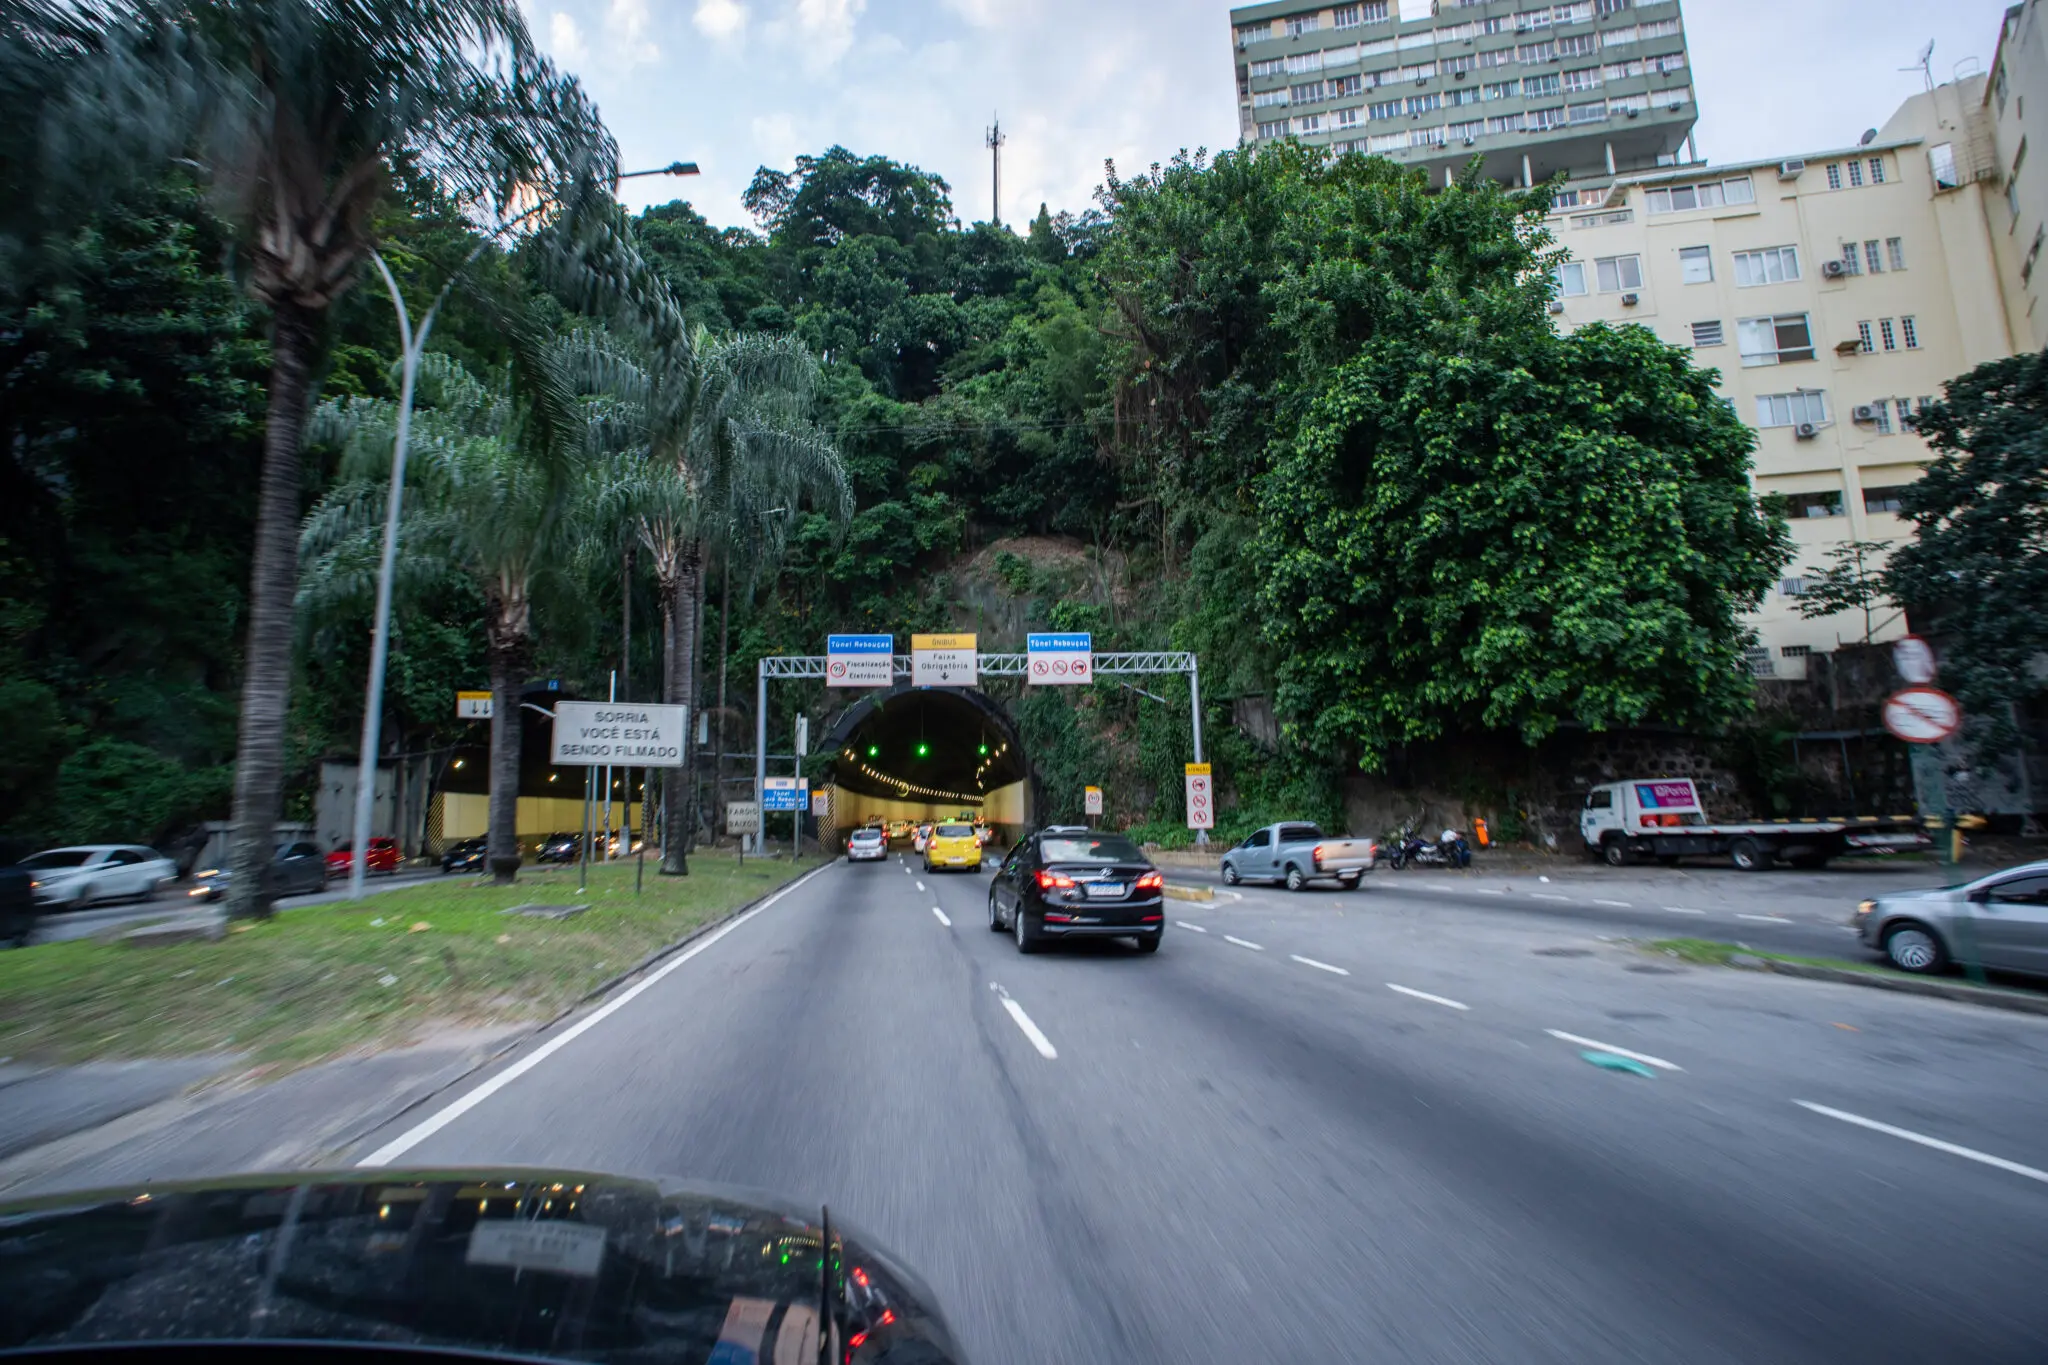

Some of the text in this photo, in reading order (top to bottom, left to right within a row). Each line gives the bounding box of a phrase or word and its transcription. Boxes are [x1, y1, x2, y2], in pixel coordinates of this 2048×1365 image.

[831, 640, 890, 649] Túnel Rebouças
[1031, 639, 1088, 648] Túnel Rebouças
[921, 662, 968, 670] Obrigatória
[849, 672, 887, 680] Eletrônica
[594, 711, 649, 723] SORRIA
[580, 726, 660, 740] VOCÊ ESTÁ
[561, 743, 678, 757] SENDO FILMADO
